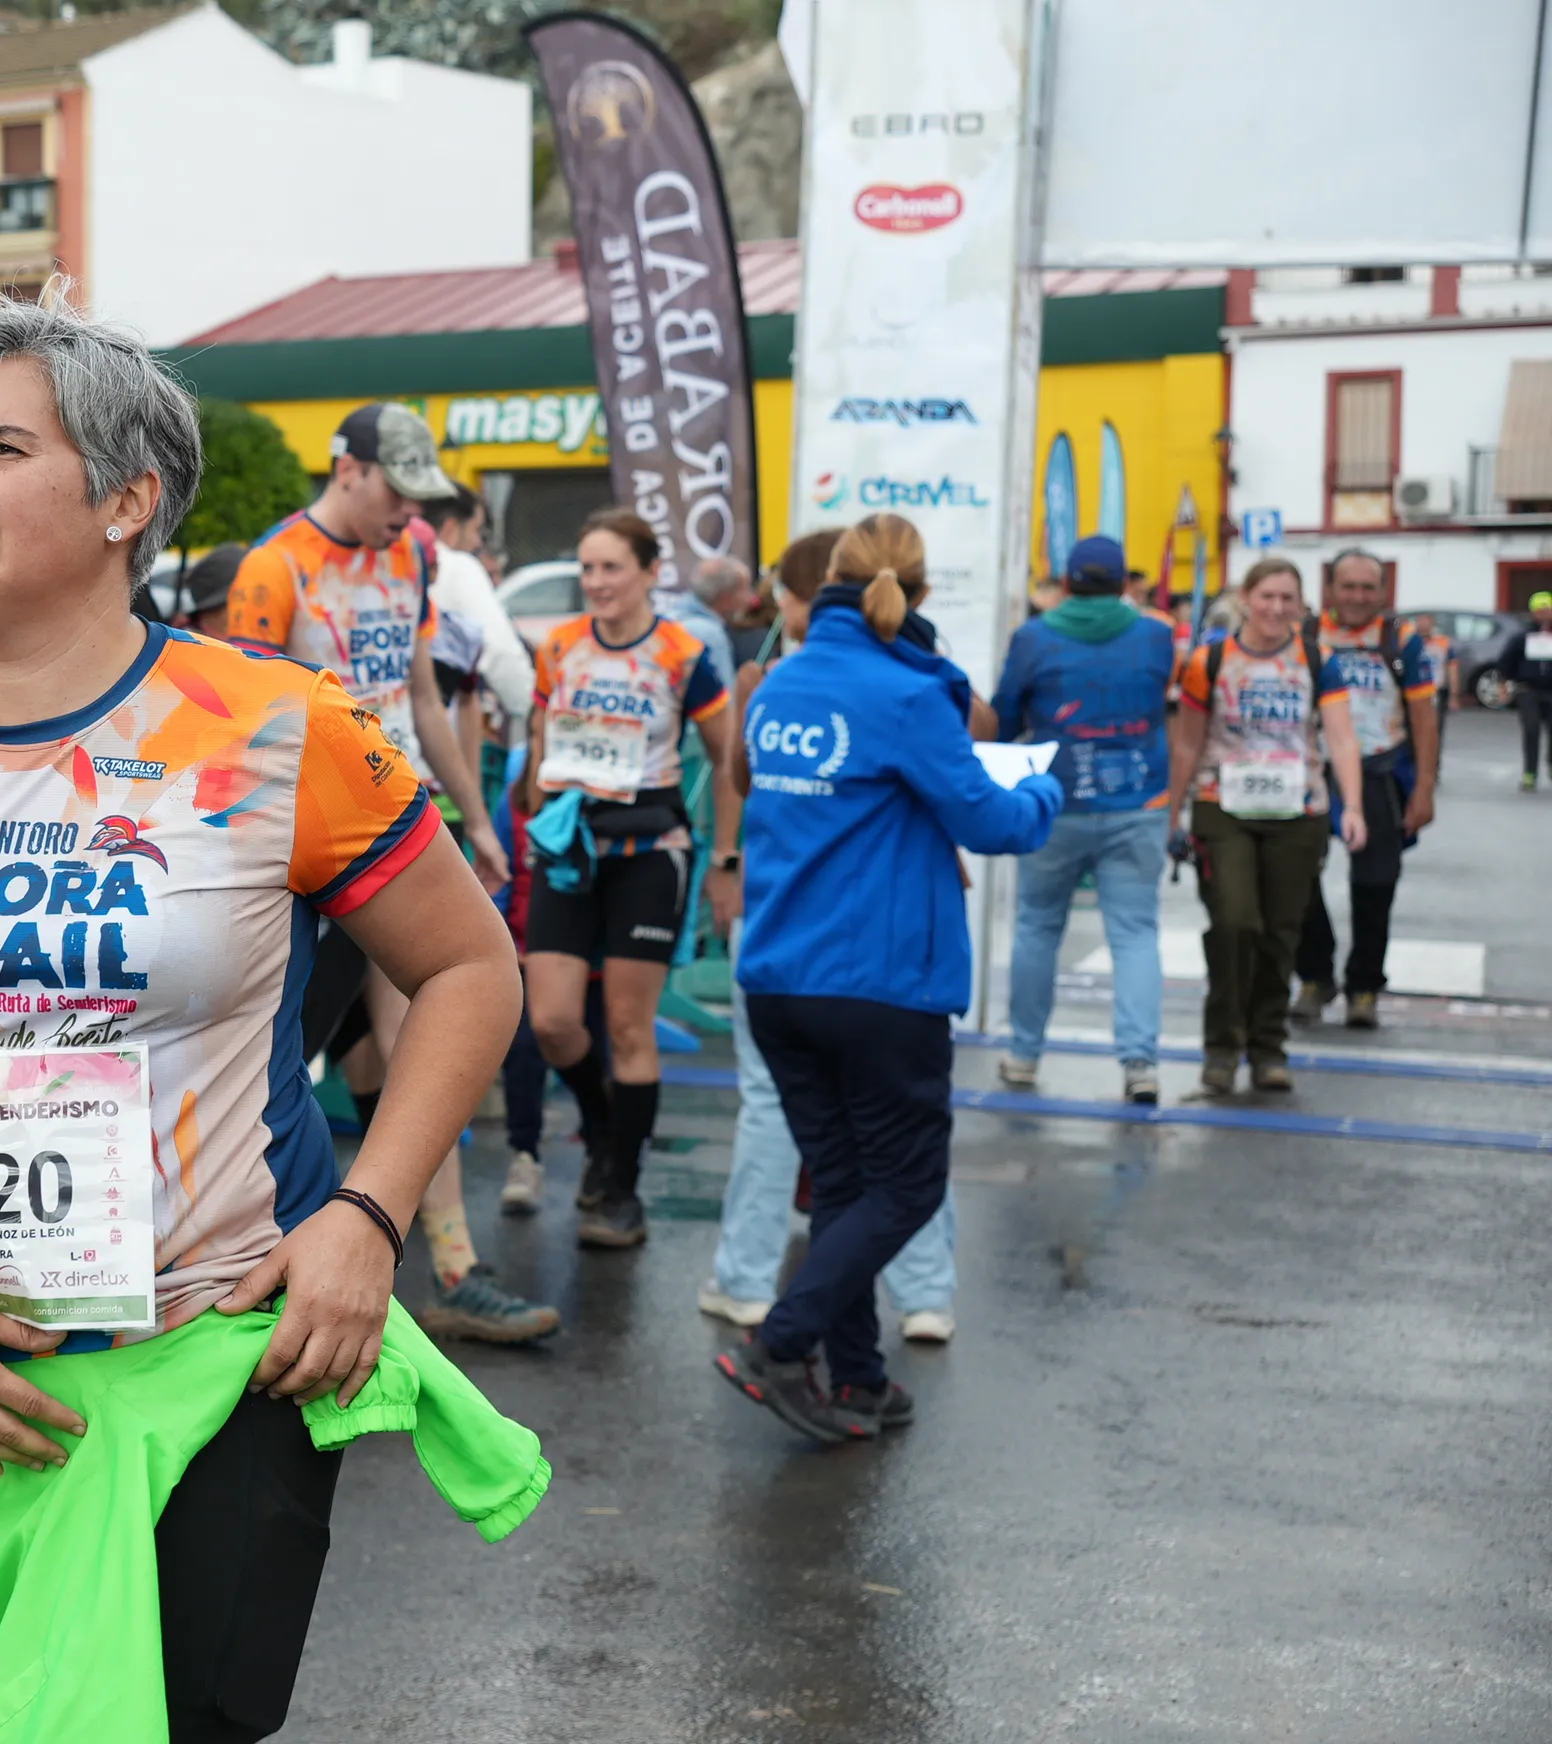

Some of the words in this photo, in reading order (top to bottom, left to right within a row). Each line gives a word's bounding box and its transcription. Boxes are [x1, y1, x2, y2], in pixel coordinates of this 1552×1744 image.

[447, 392, 607, 453] masy
[572, 689, 655, 717] EPORA
[758, 719, 825, 758] GCC
[108, 759, 165, 774] TAKELOT
[36, 993, 52, 1013] de
[57, 994, 137, 1014] Senderismo
[21, 1229, 36, 1239] DE
[40, 1226, 75, 1238] LEÓN
[65, 1270, 129, 1287] direlux
[90, 1304, 123, 1315] comida
